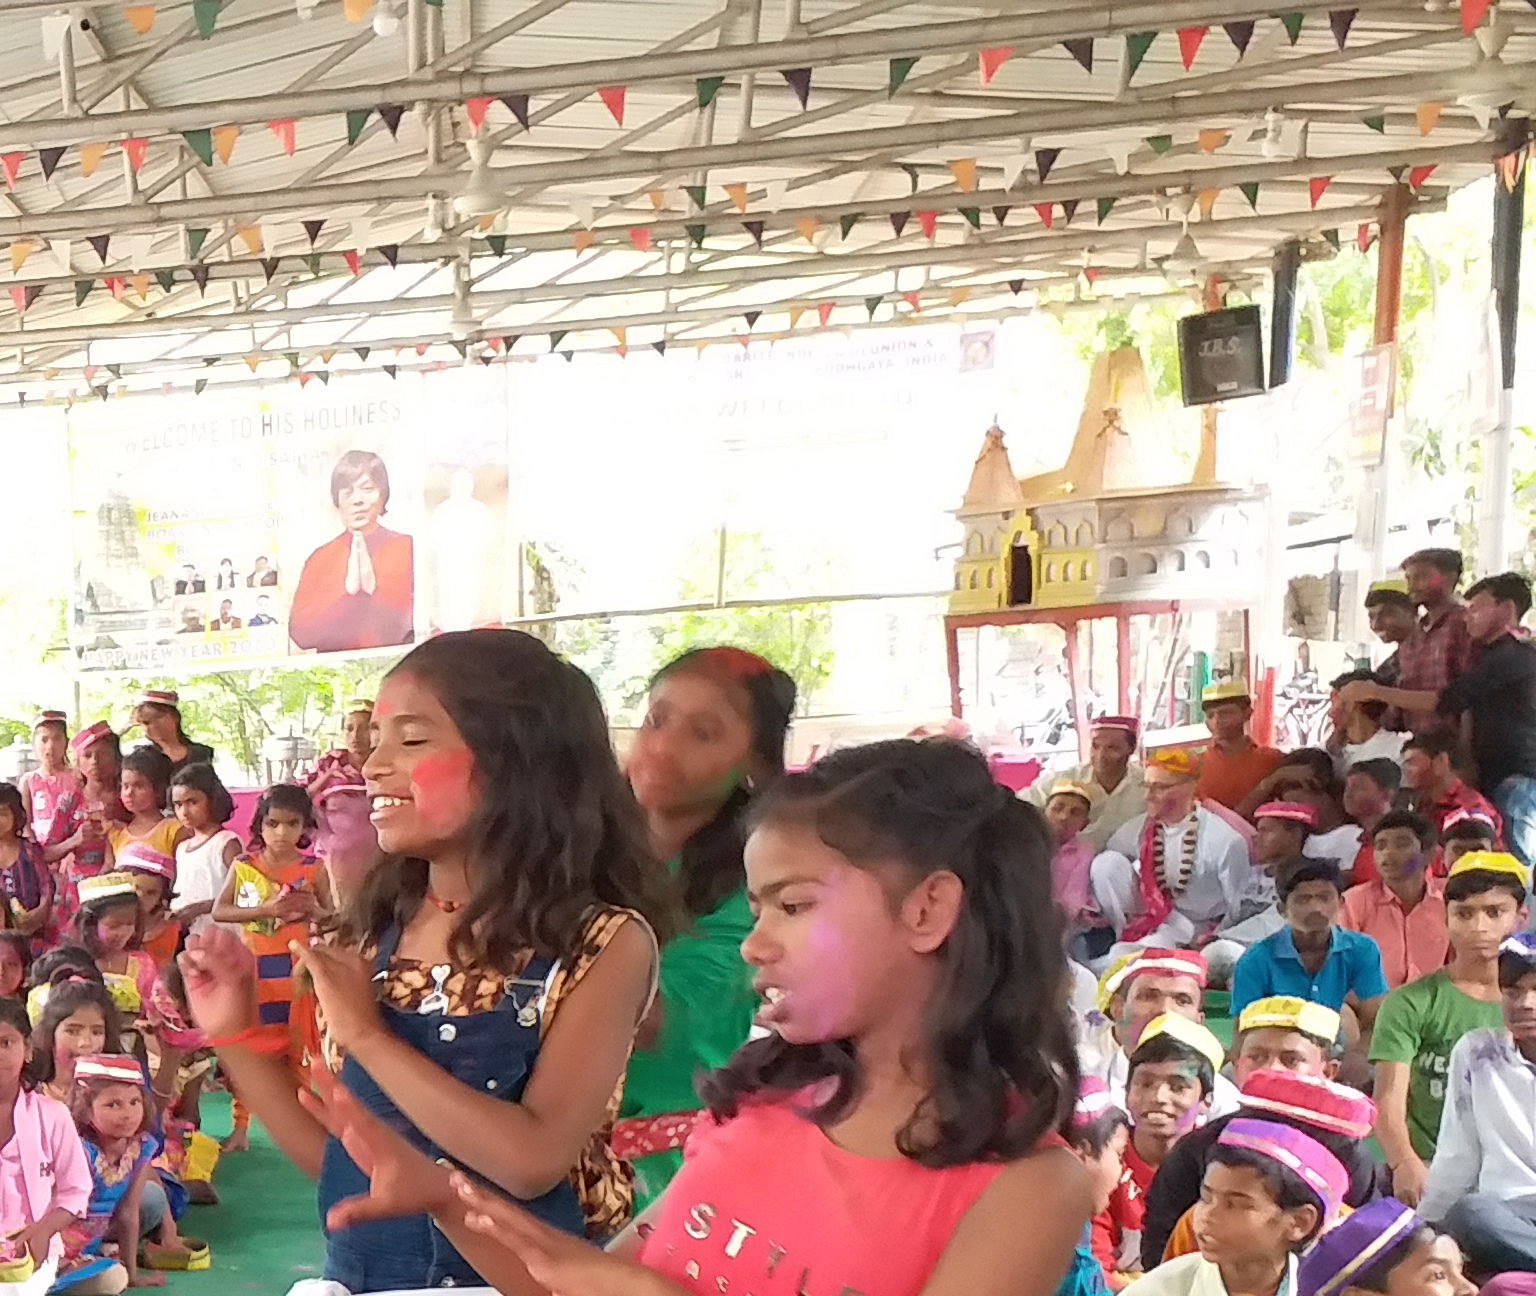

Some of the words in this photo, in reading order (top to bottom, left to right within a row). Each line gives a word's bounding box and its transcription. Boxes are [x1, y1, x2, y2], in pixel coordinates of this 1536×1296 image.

[230, 417, 252, 440] TO
[261, 411, 294, 437] HIS
[303, 400, 402, 433] HOLINESS
[84, 650, 136, 663] HAPPY
[140, 645, 174, 661] NEW
[180, 642, 223, 657] YEAR
[1418, 1051, 1450, 1073] WE
